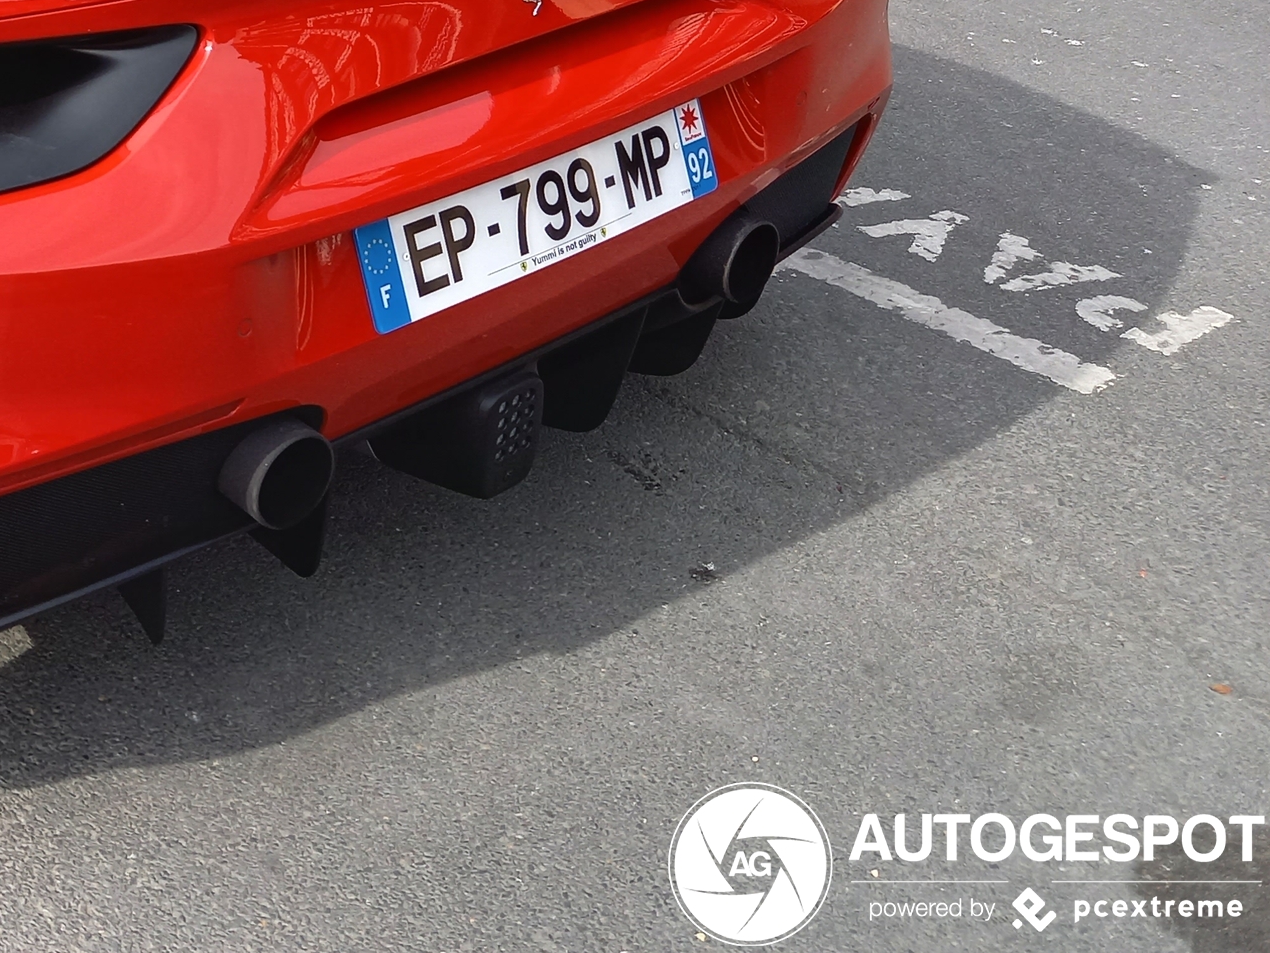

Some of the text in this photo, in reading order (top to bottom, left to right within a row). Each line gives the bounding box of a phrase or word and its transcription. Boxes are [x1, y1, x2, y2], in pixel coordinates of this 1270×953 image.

[687, 147, 713, 184] 92
[403, 124, 671, 298] EP-799-MP
[531, 233, 597, 266] Yummi is not guilty
[380, 283, 392, 309] F
